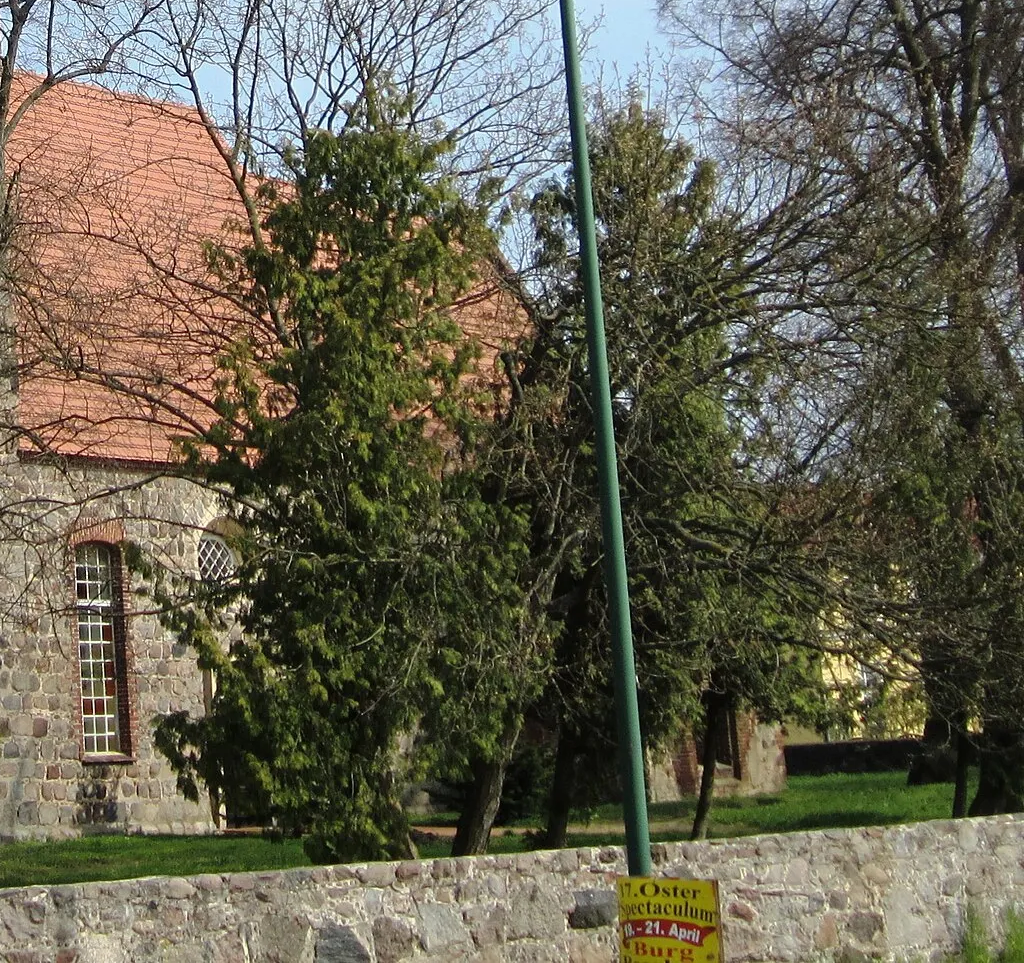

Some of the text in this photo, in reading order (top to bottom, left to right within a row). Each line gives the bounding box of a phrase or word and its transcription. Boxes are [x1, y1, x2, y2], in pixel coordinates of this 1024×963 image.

[645, 920, 665, 935] 21.
[669, 923, 700, 944] April
[634, 941, 695, 962] Burg
